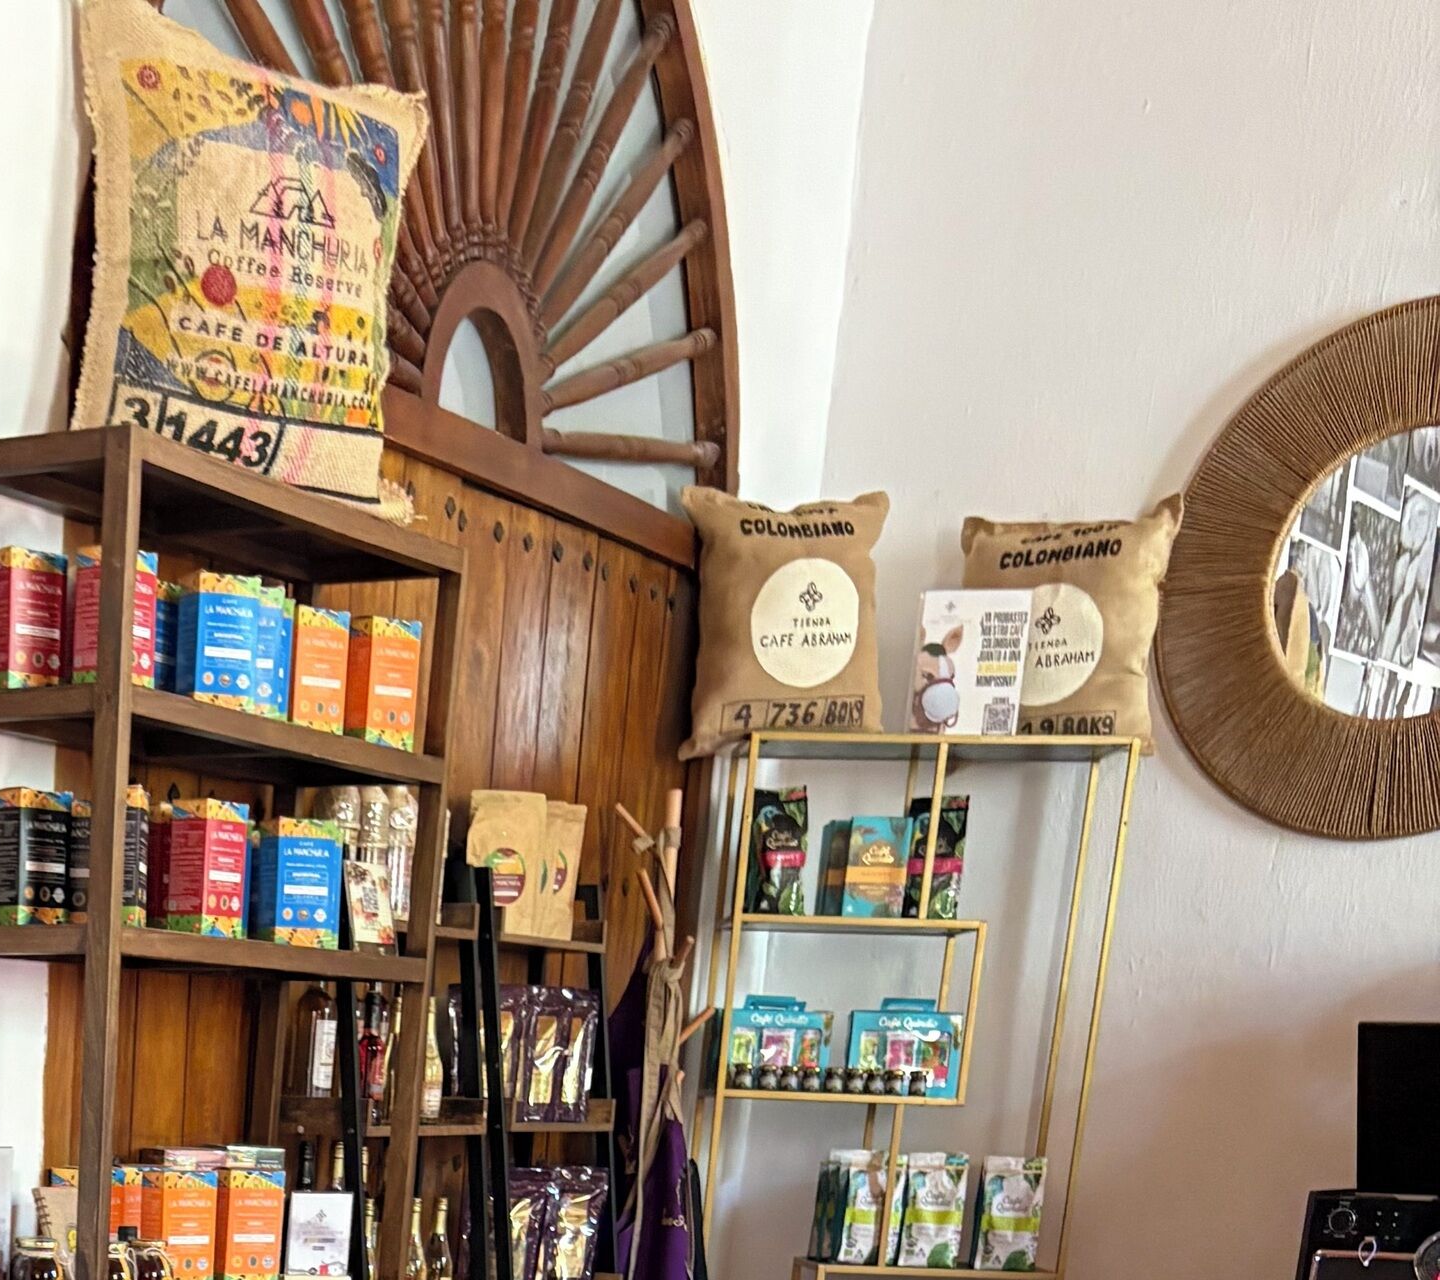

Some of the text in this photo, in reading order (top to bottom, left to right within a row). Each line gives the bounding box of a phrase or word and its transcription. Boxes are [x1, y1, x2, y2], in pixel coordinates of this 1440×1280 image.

[196, 208, 369, 278] LA MANCHURIA
[207, 249, 364, 297] Coffee Reserve
[179, 316, 369, 367] CAFE DE ALTURA
[740, 518, 855, 538] COLOMBIANO
[999, 538, 1123, 570] COLOMBIANO
[793, 616, 831, 628] TIENDA
[760, 631, 852, 648] CAFE ABRAHAM
[1034, 651, 1095, 669] ABRAHAM
[768, 701, 818, 728] 736
